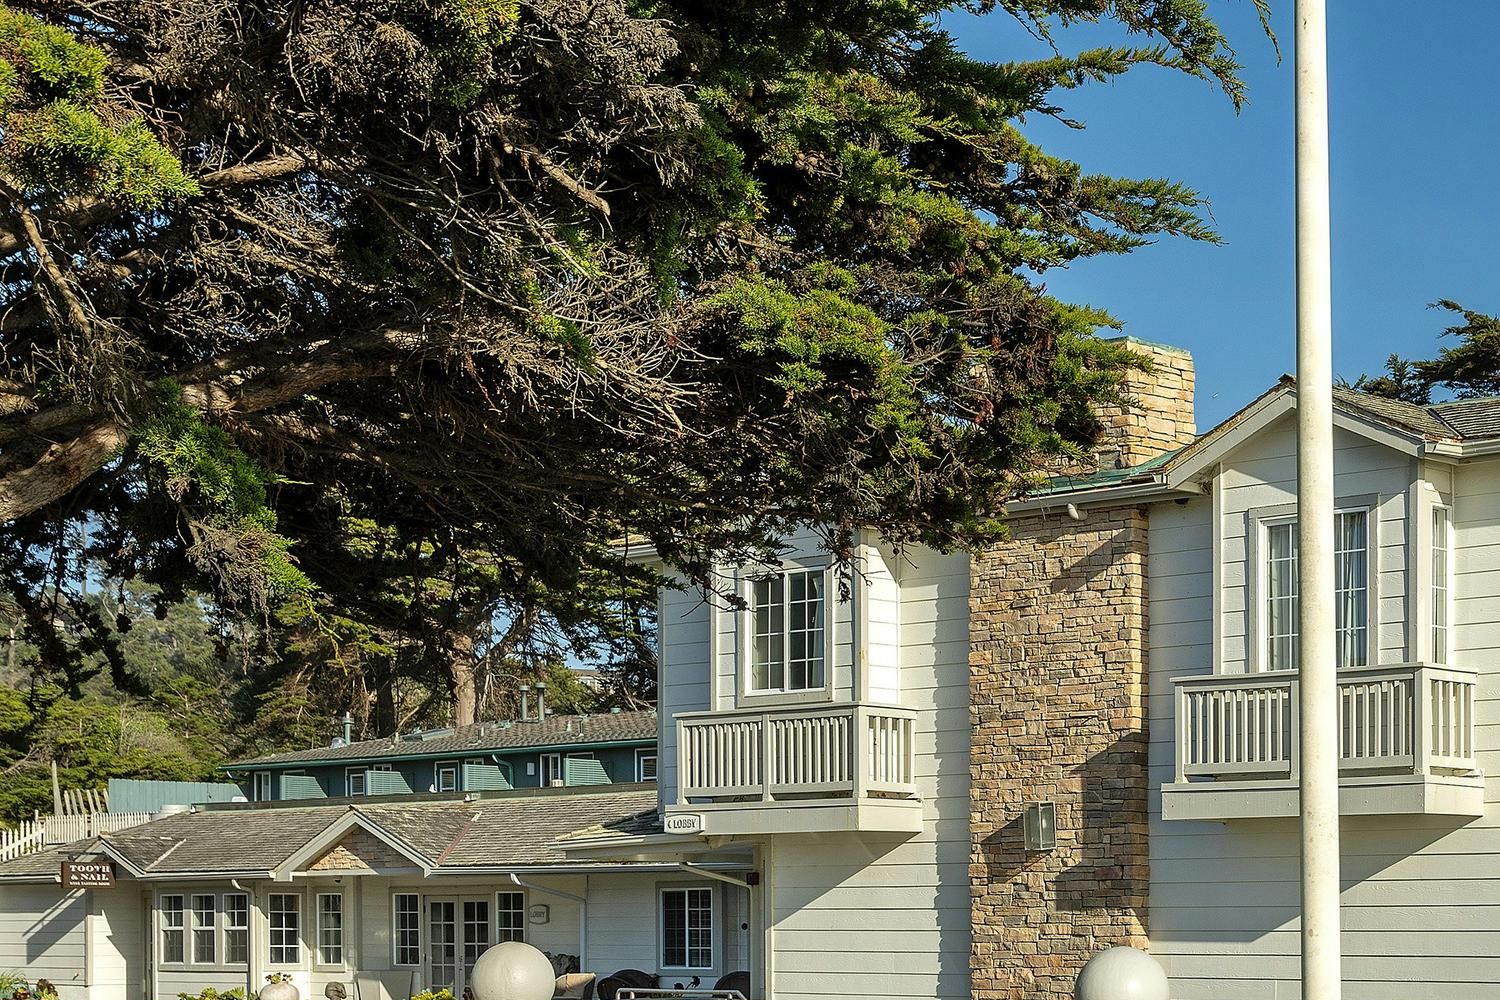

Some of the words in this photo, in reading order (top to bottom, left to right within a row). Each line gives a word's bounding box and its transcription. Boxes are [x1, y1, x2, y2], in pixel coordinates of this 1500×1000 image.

[673, 819, 697, 829] LOBBY
[69, 865, 110, 873] TOOTH
[80, 873, 109, 881] NAIL
